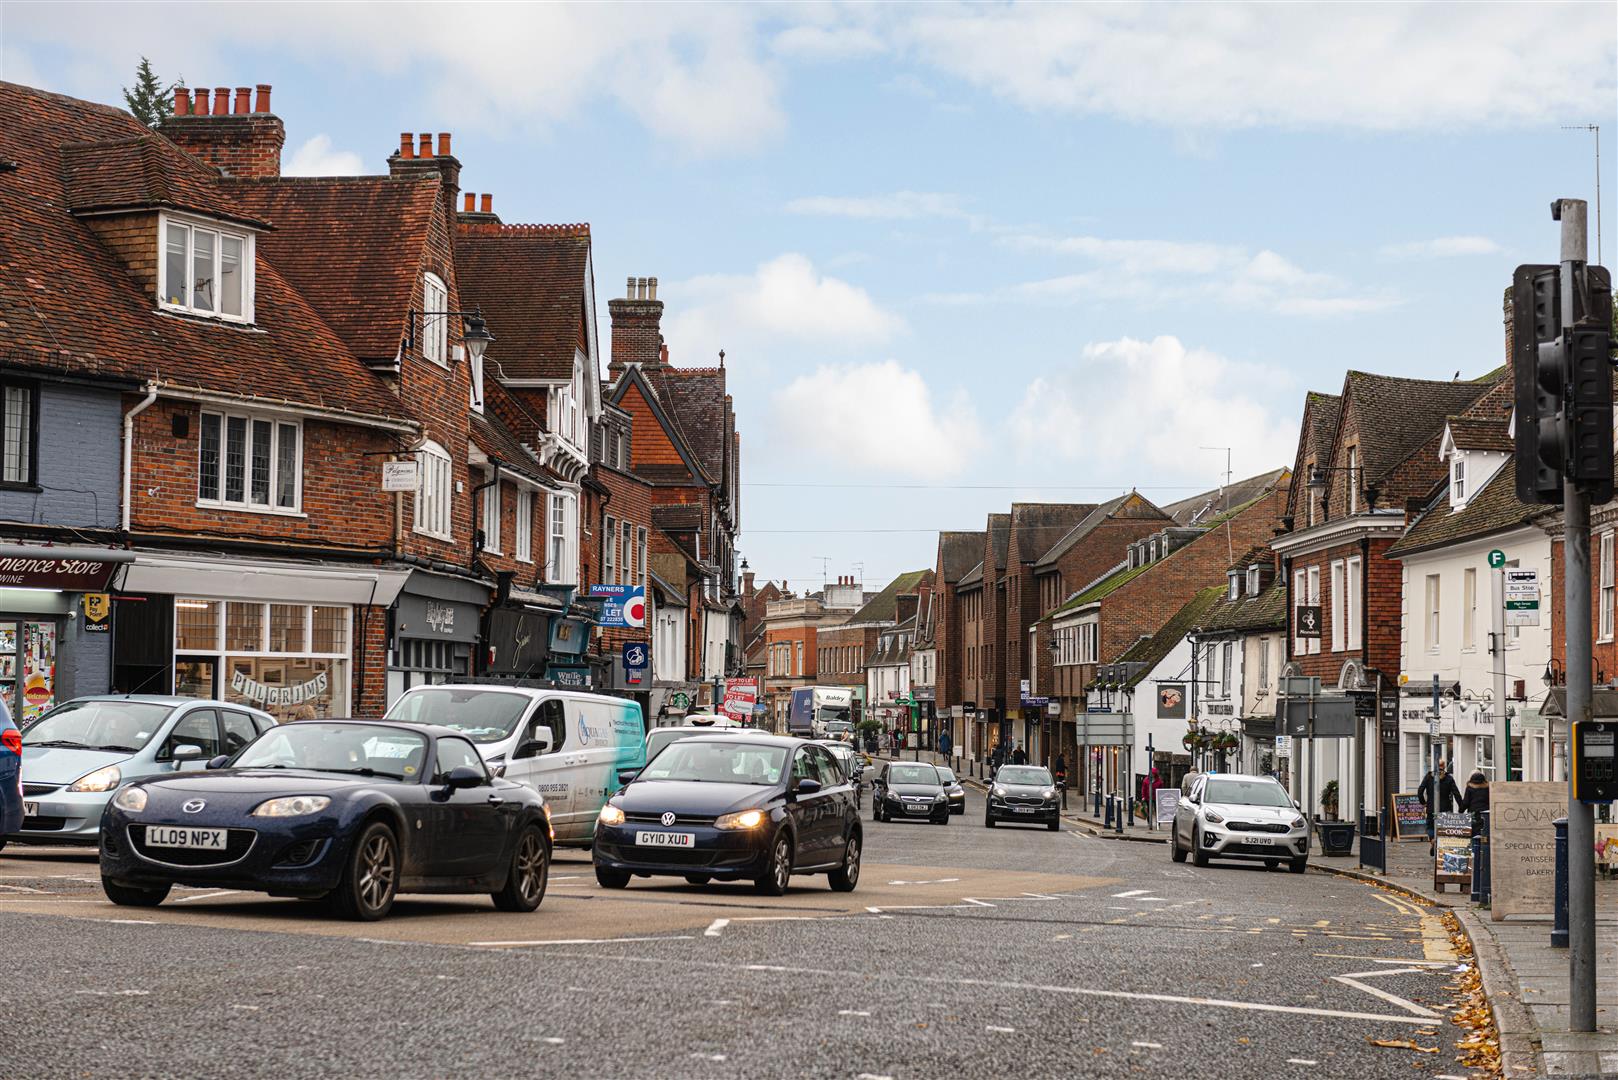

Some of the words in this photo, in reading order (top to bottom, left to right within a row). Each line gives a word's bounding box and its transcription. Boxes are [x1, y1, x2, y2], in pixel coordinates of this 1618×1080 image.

[1492, 552, 1502, 565] F
[56, 560, 103, 575] Store
[592, 585, 625, 593] RAYNERS
[605, 609, 622, 617] LET
[233, 674, 327, 703] PILGRIMS
[826, 694, 845, 702] Baldry
[151, 829, 187, 845] LL09
[191, 831, 220, 846] NPX
[642, 833, 665, 844] GY10
[667, 834, 688, 845] XUD
[1504, 842, 1544, 850] SPECIALITY
[1526, 868, 1554, 876] BAKERY
